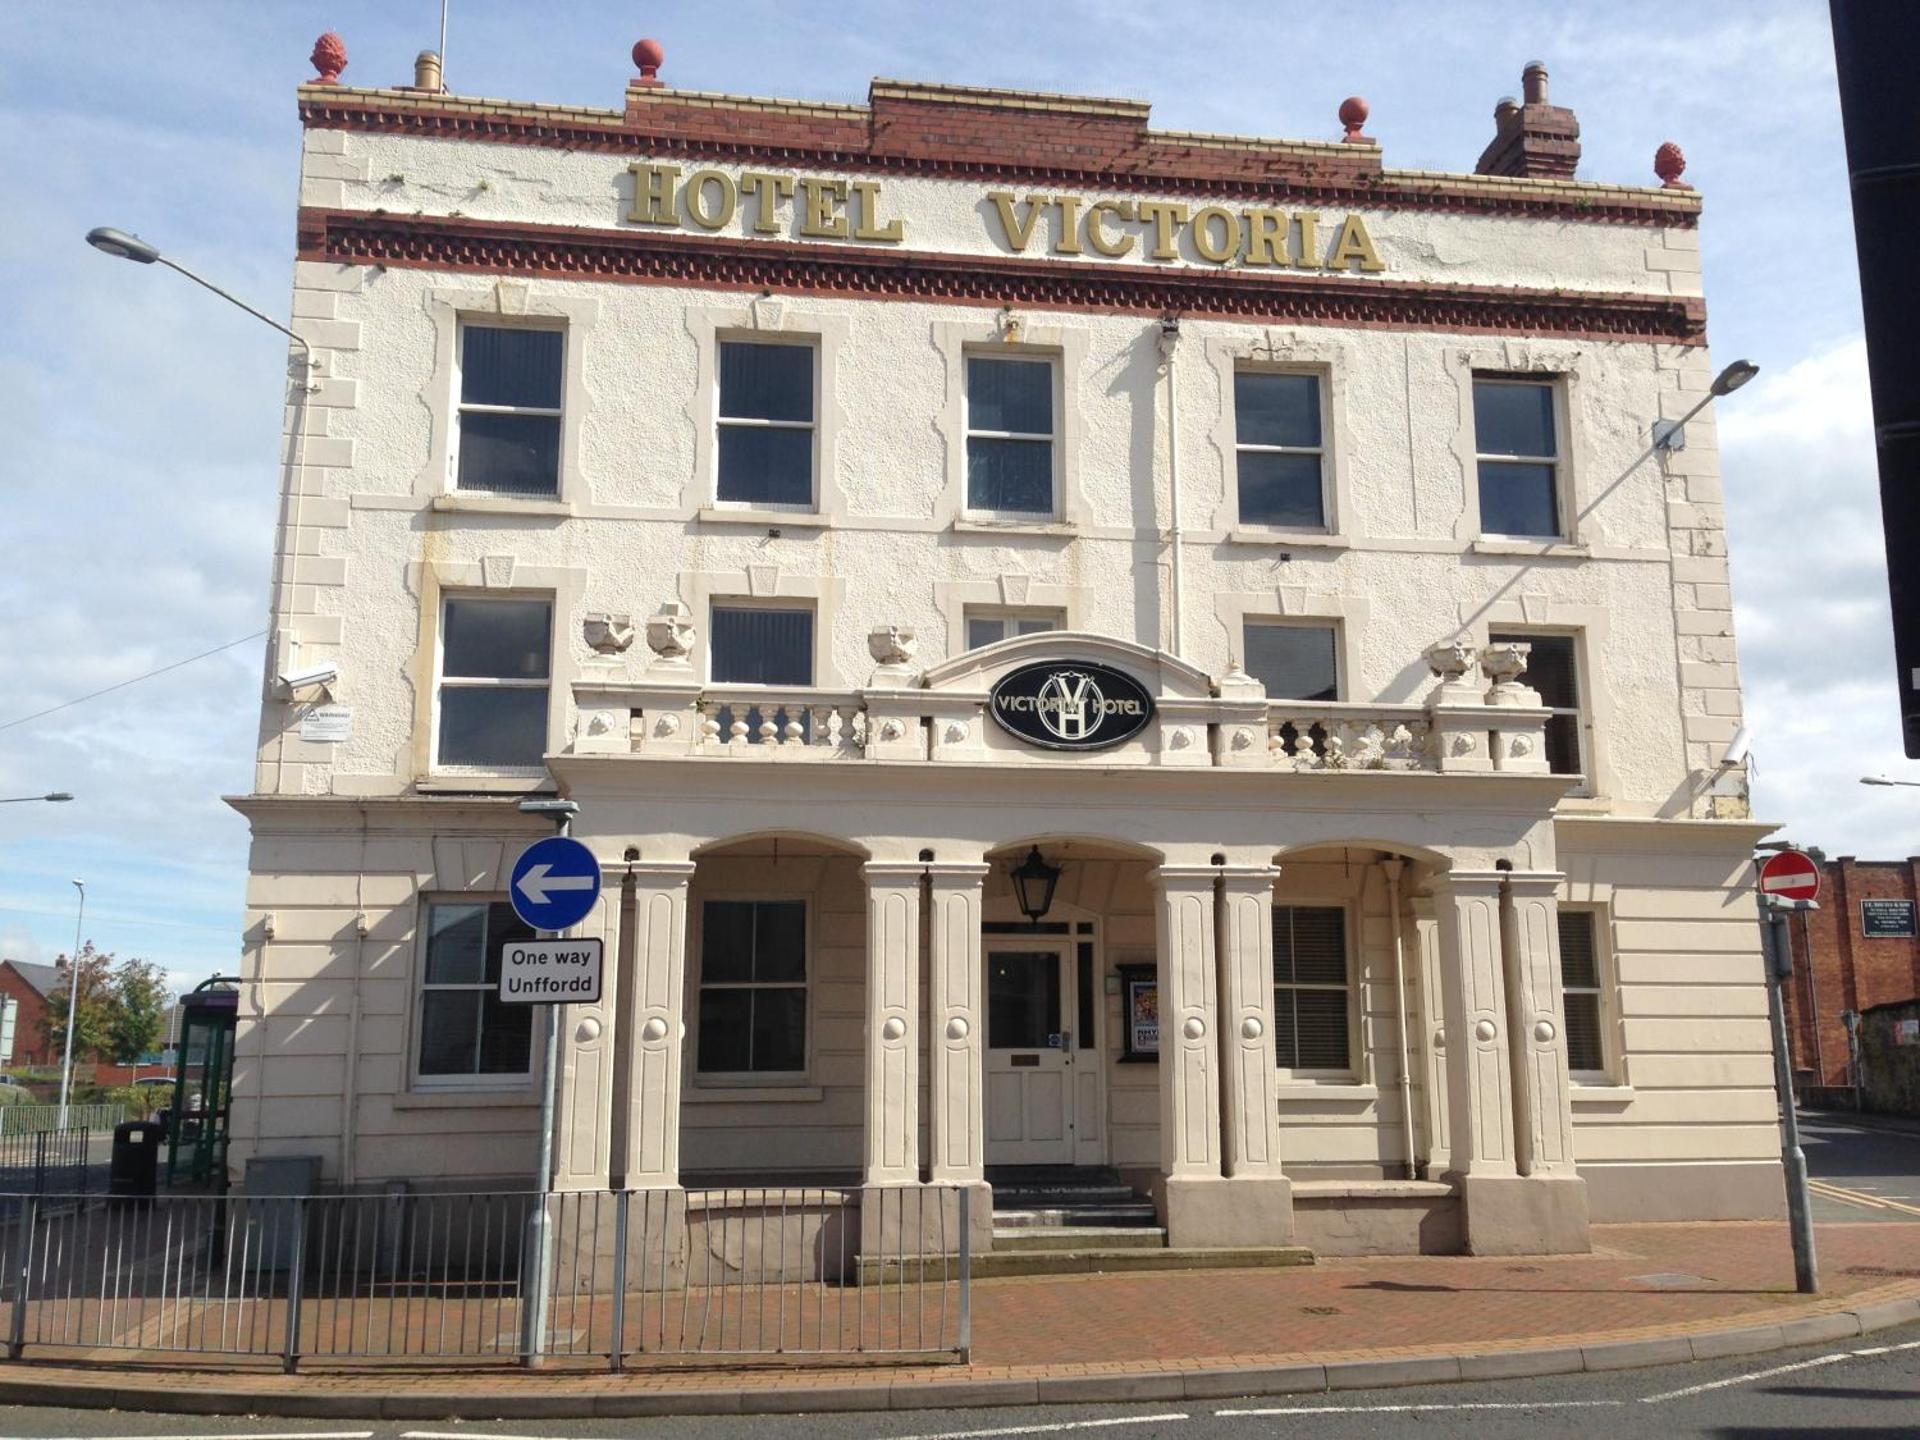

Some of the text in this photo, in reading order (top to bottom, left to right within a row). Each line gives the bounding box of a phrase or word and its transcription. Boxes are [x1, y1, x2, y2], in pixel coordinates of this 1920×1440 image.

[627, 162, 1386, 272] HOTEL VICTORIA
[1092, 698, 1144, 716] HOTEL
[511, 949, 591, 967] One way
[508, 976, 592, 993] Unffordd
